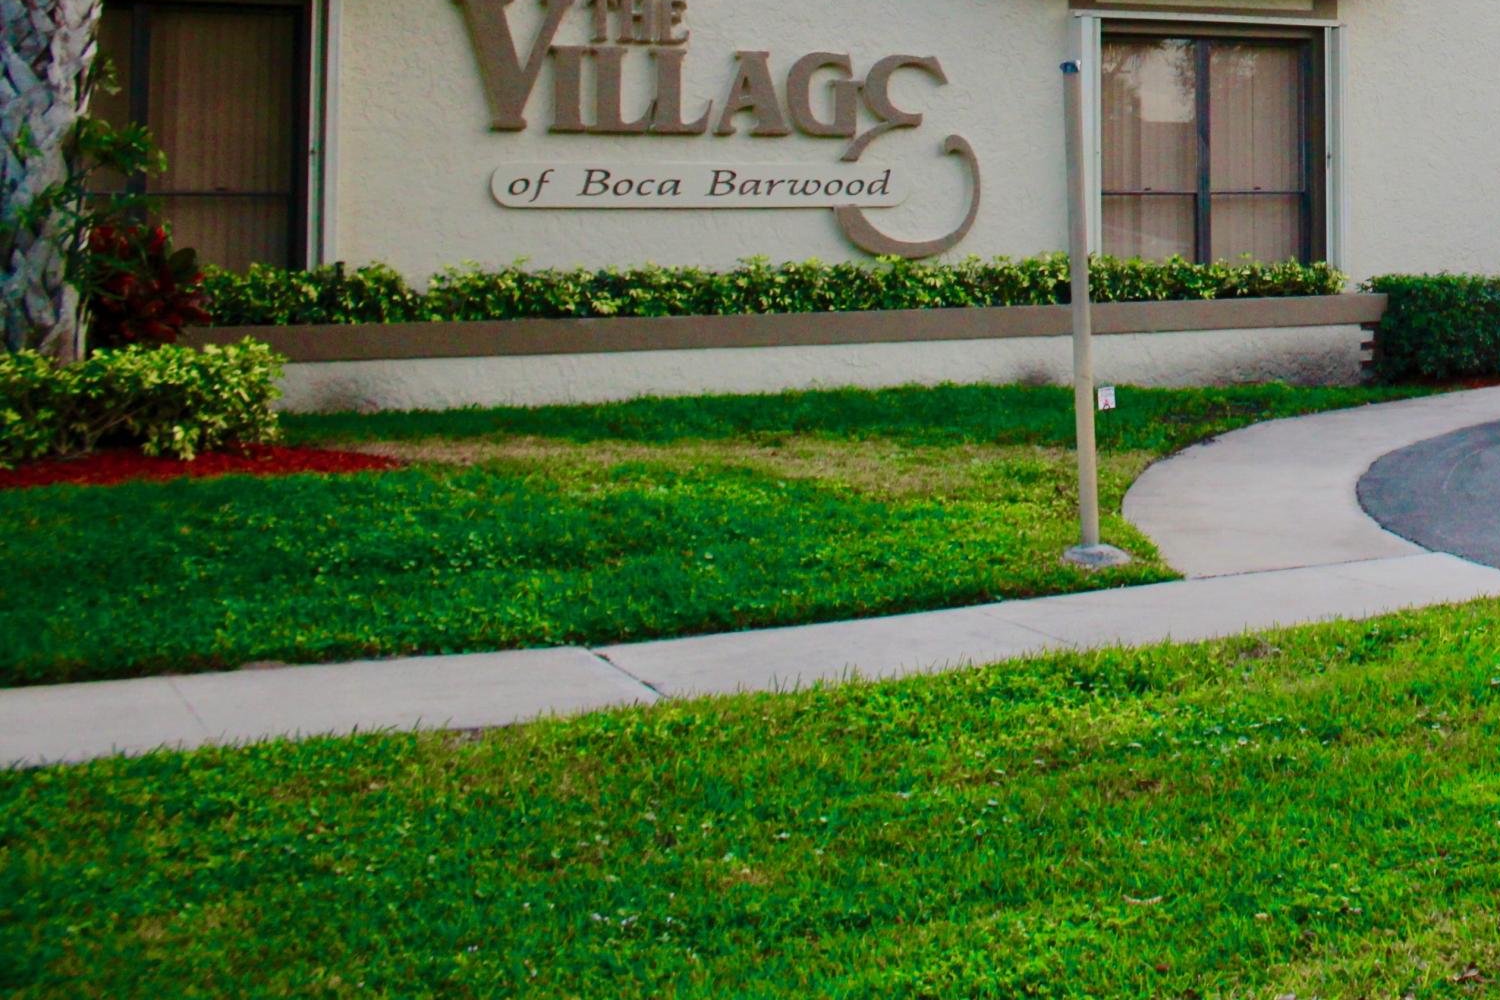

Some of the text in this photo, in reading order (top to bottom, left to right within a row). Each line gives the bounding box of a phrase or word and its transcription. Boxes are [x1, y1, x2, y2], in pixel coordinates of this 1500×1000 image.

[507, 168, 891, 202] of Boca Barwood
